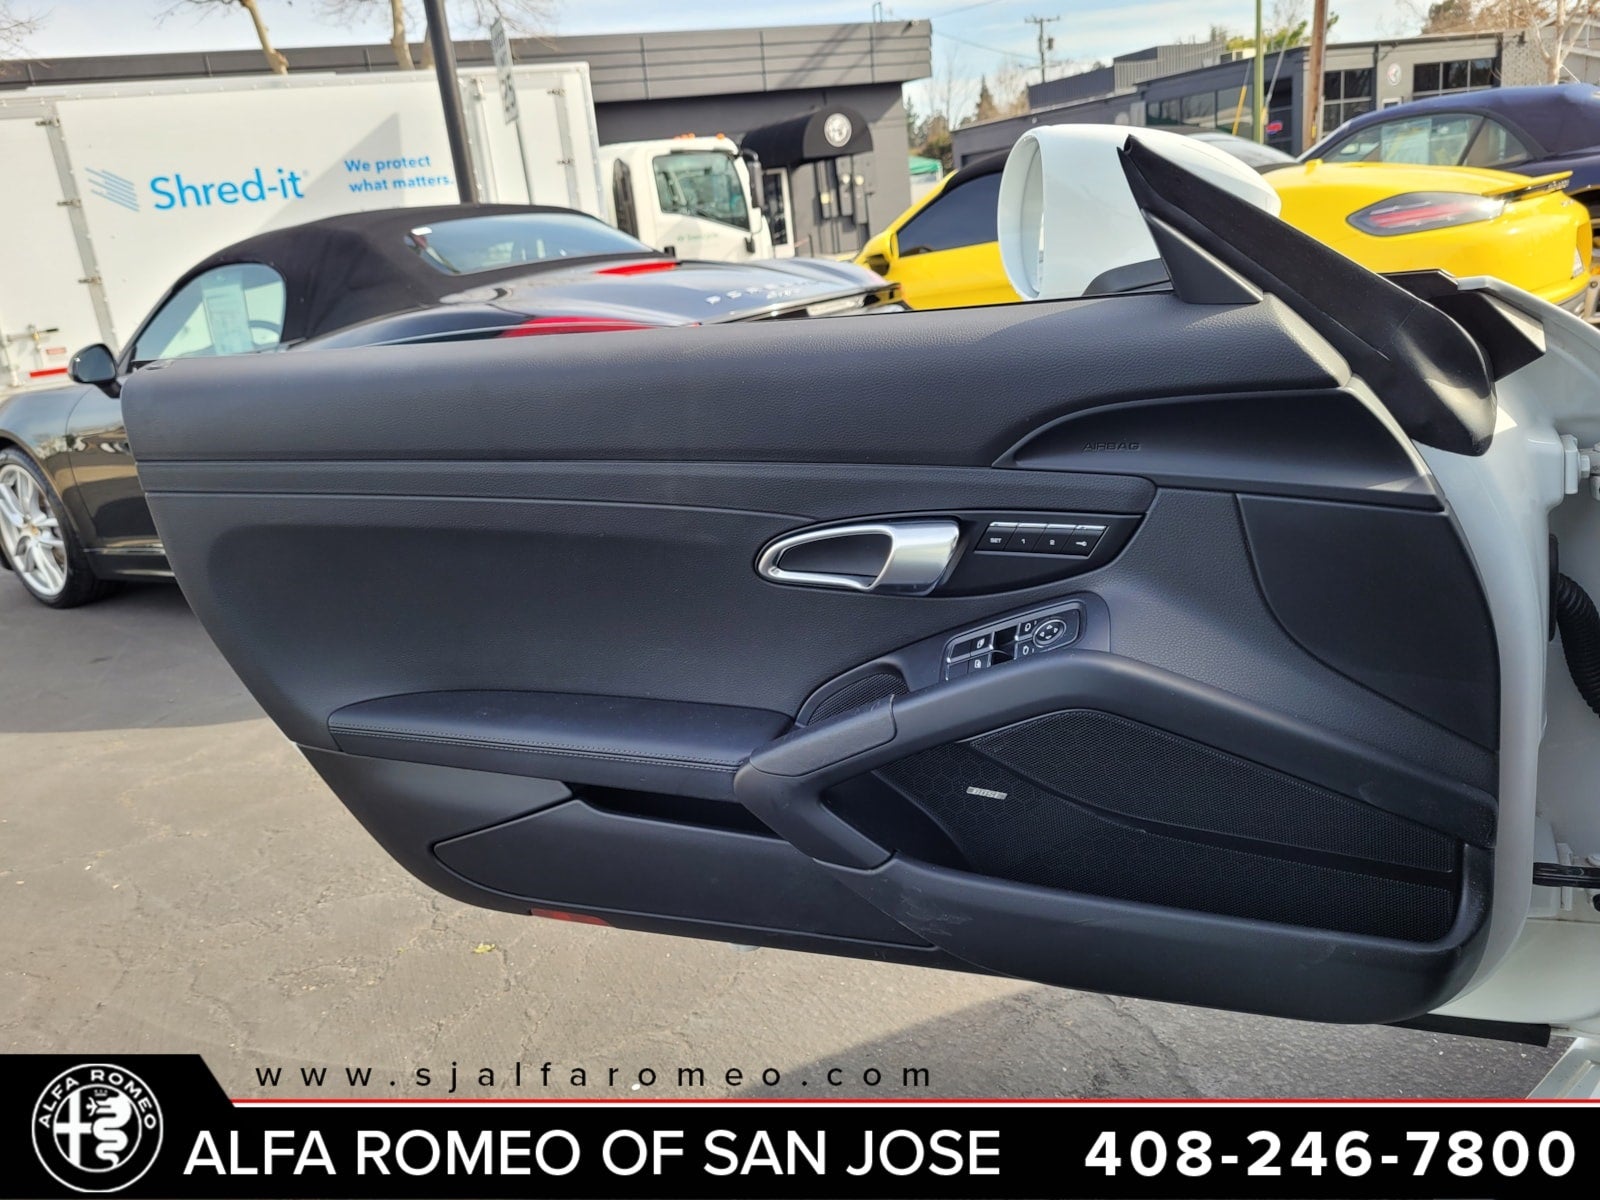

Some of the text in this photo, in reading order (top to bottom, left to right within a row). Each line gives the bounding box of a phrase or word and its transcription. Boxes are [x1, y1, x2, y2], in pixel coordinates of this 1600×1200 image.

[344, 156, 431, 173] We protect
[150, 168, 304, 209] Shred-it
[349, 176, 454, 193] what matters.
[1080, 441, 1141, 451] AIRBAG
